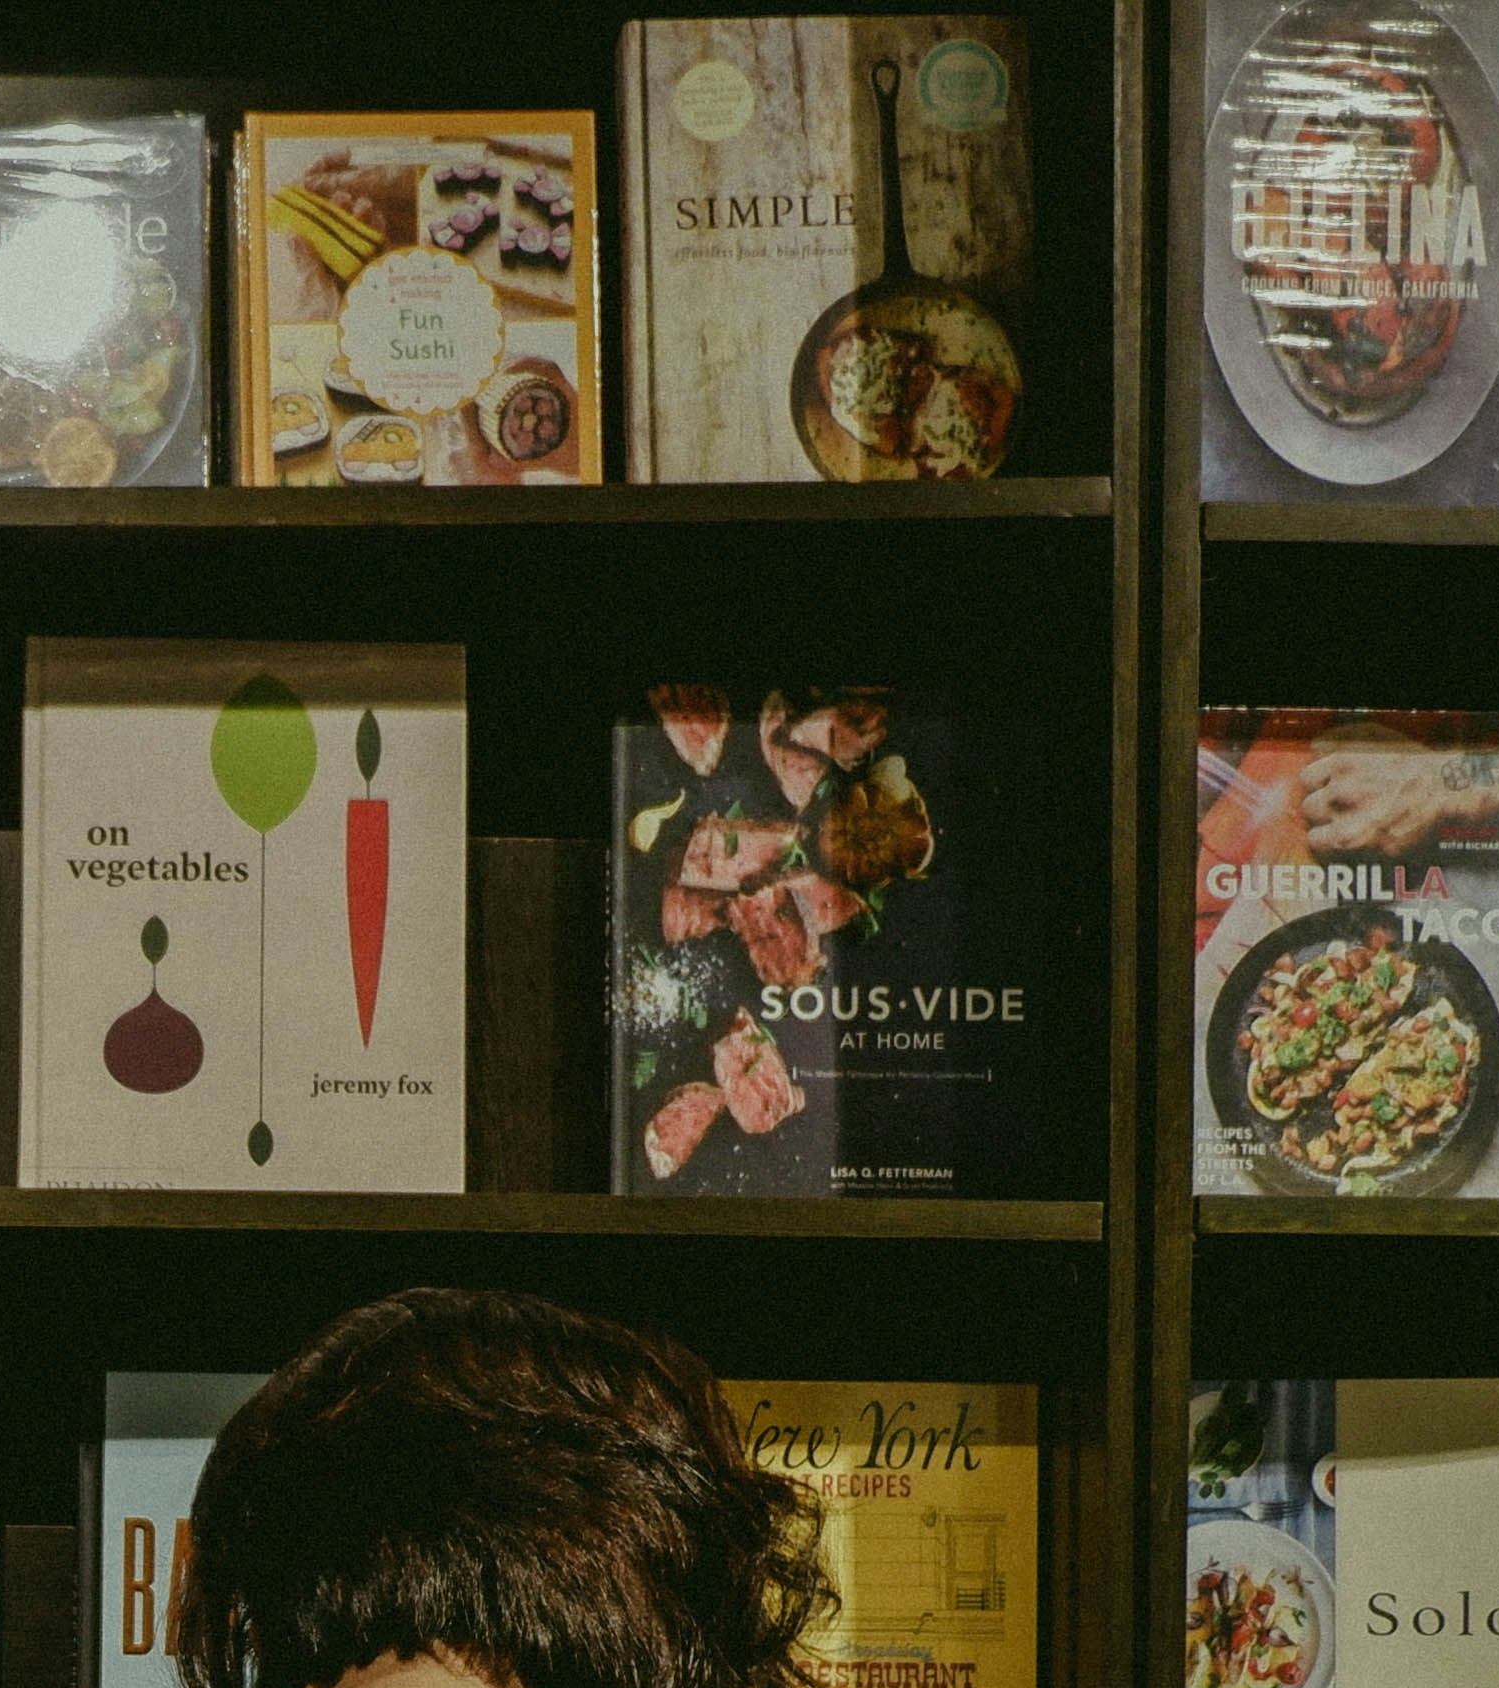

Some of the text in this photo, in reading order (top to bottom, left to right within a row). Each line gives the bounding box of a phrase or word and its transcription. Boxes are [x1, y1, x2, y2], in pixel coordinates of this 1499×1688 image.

[675, 192, 857, 231] SIMPLE
[399, 307, 444, 331] Fun
[389, 338, 455, 361] Sushi
[87, 824, 130, 848] on
[67, 852, 250, 887] vegetables
[1207, 865, 1448, 901] GUERRILLA
[839, 1032, 945, 1050] AT HOME
[310, 1072, 434, 1099] jeremy fox
[831, 1167, 954, 1180] LISA Q. FETTERMAN
